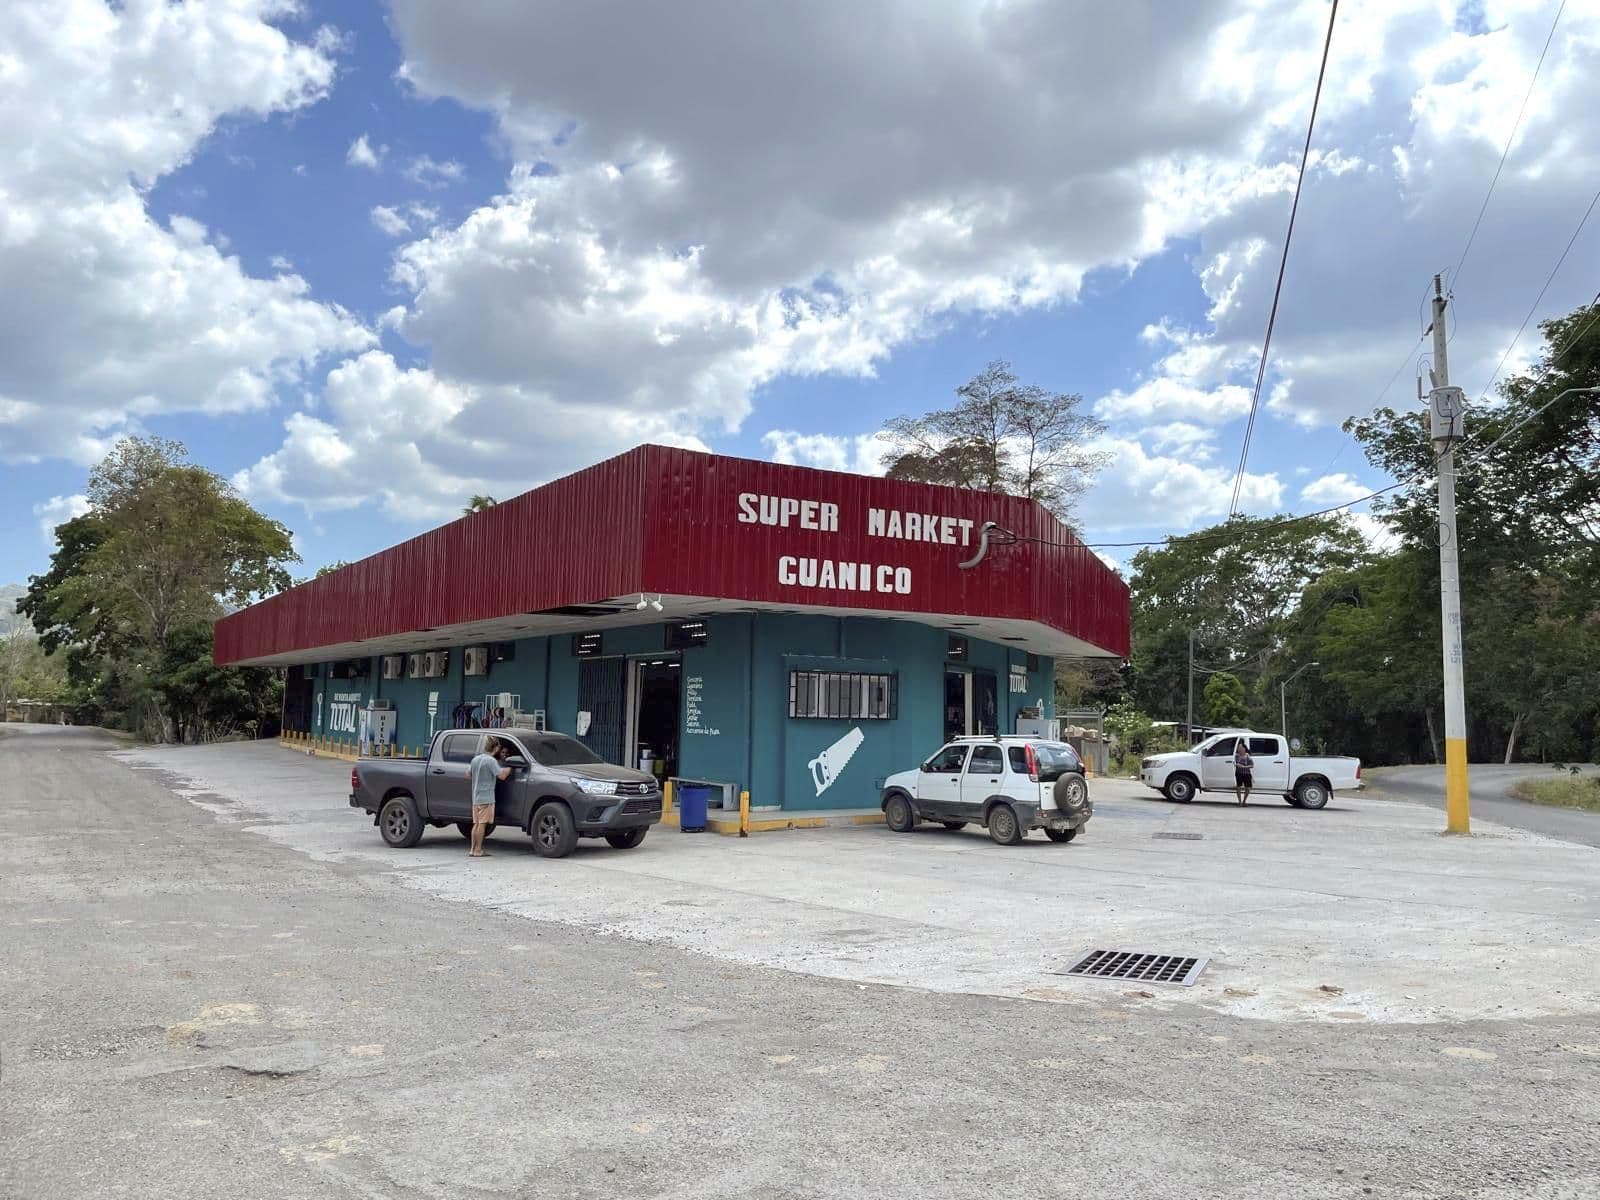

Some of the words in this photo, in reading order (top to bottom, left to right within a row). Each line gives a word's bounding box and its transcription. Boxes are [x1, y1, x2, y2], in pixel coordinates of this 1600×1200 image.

[738, 492, 839, 532] SUPER
[868, 507, 974, 547] MARKET
[329, 703, 356, 733] TOTAL
